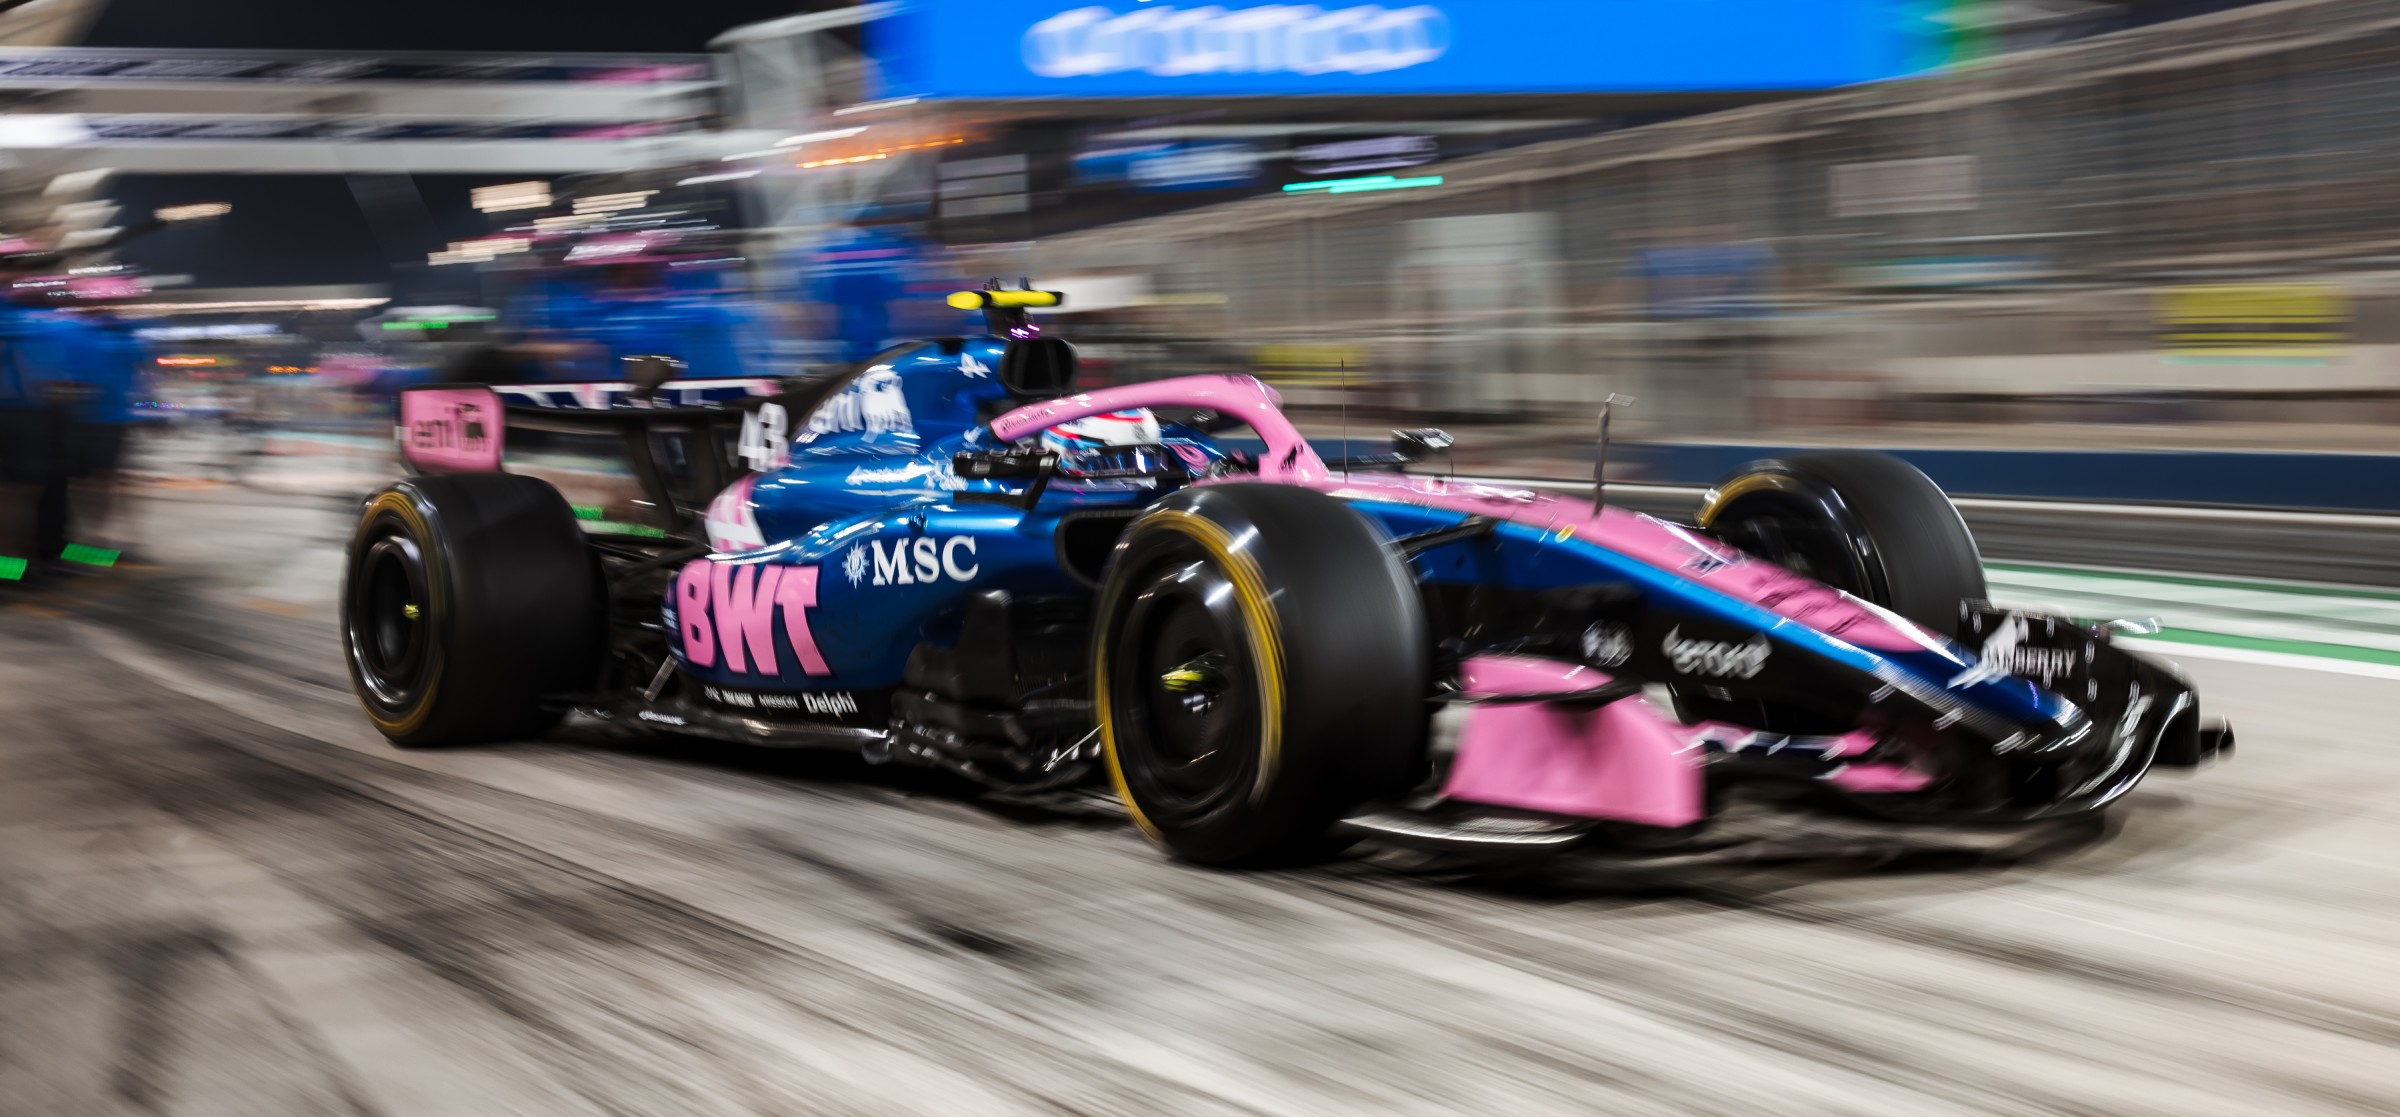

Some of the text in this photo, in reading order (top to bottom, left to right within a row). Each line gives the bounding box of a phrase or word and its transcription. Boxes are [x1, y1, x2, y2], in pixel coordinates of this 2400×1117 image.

[738, 402, 788, 472] 43
[872, 536, 979, 586] MSC
[677, 559, 831, 676] BWT
[802, 691, 859, 721] Delphi
